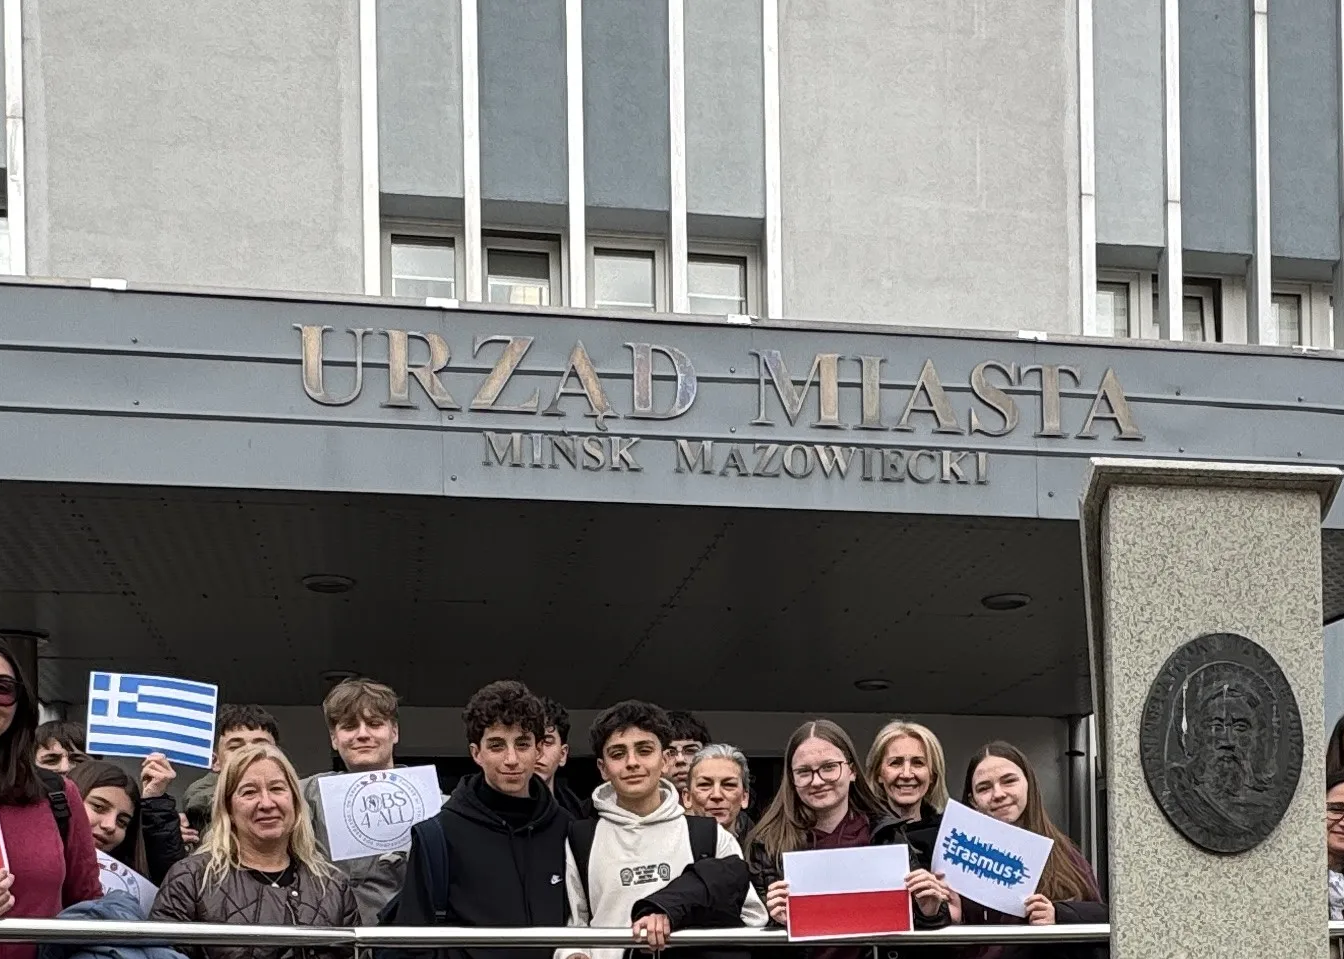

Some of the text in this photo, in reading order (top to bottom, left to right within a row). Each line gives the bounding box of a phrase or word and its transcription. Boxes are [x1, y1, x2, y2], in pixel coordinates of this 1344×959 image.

[292, 323, 1146, 441] URZĄD MIASTA
[481, 429, 990, 485] MIŃSK MAZOWIECKI
[359, 791, 407, 813] JOBS
[361, 813, 371, 828] 4
[377, 806, 413, 827] ALL
[947, 838, 1023, 879] Erasmus+
